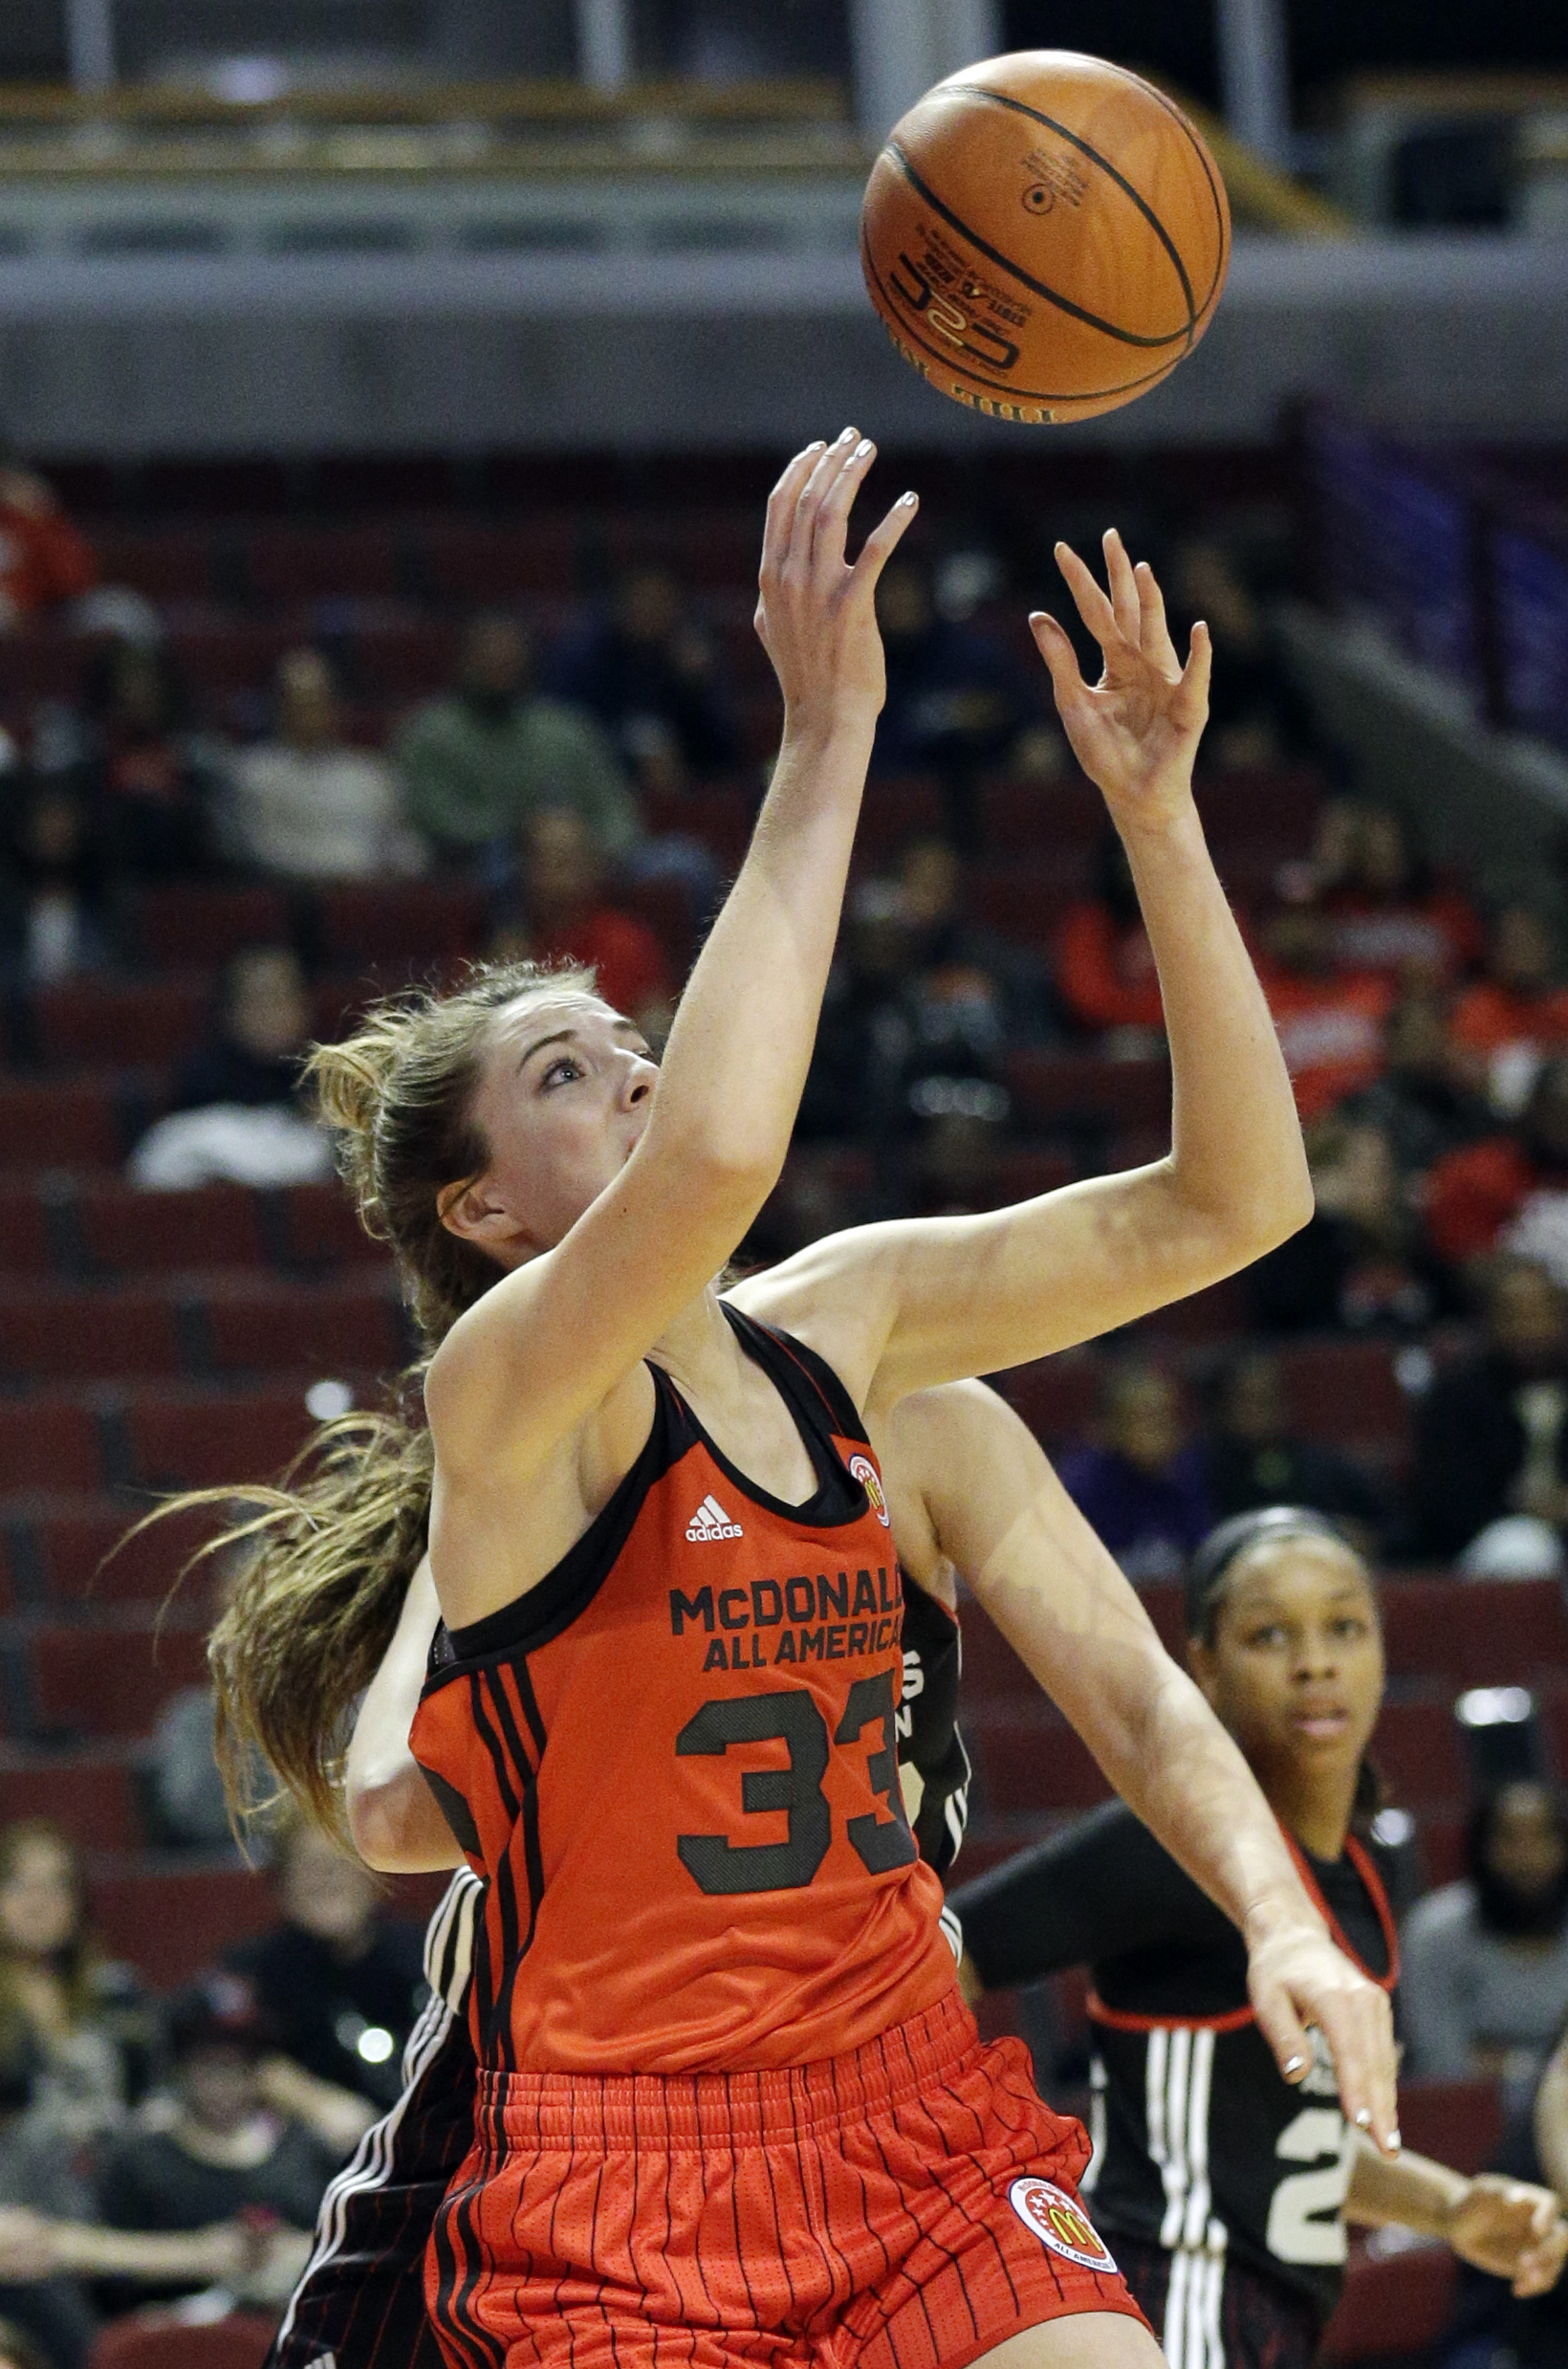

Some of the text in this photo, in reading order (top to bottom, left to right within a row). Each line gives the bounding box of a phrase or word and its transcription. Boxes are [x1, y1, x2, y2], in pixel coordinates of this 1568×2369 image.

[685, 1524, 743, 1542] adidas
[702, 1633, 766, 1671] ALL
[676, 1668, 918, 1895] 33
[1054, 2243, 1073, 2256] ALL
